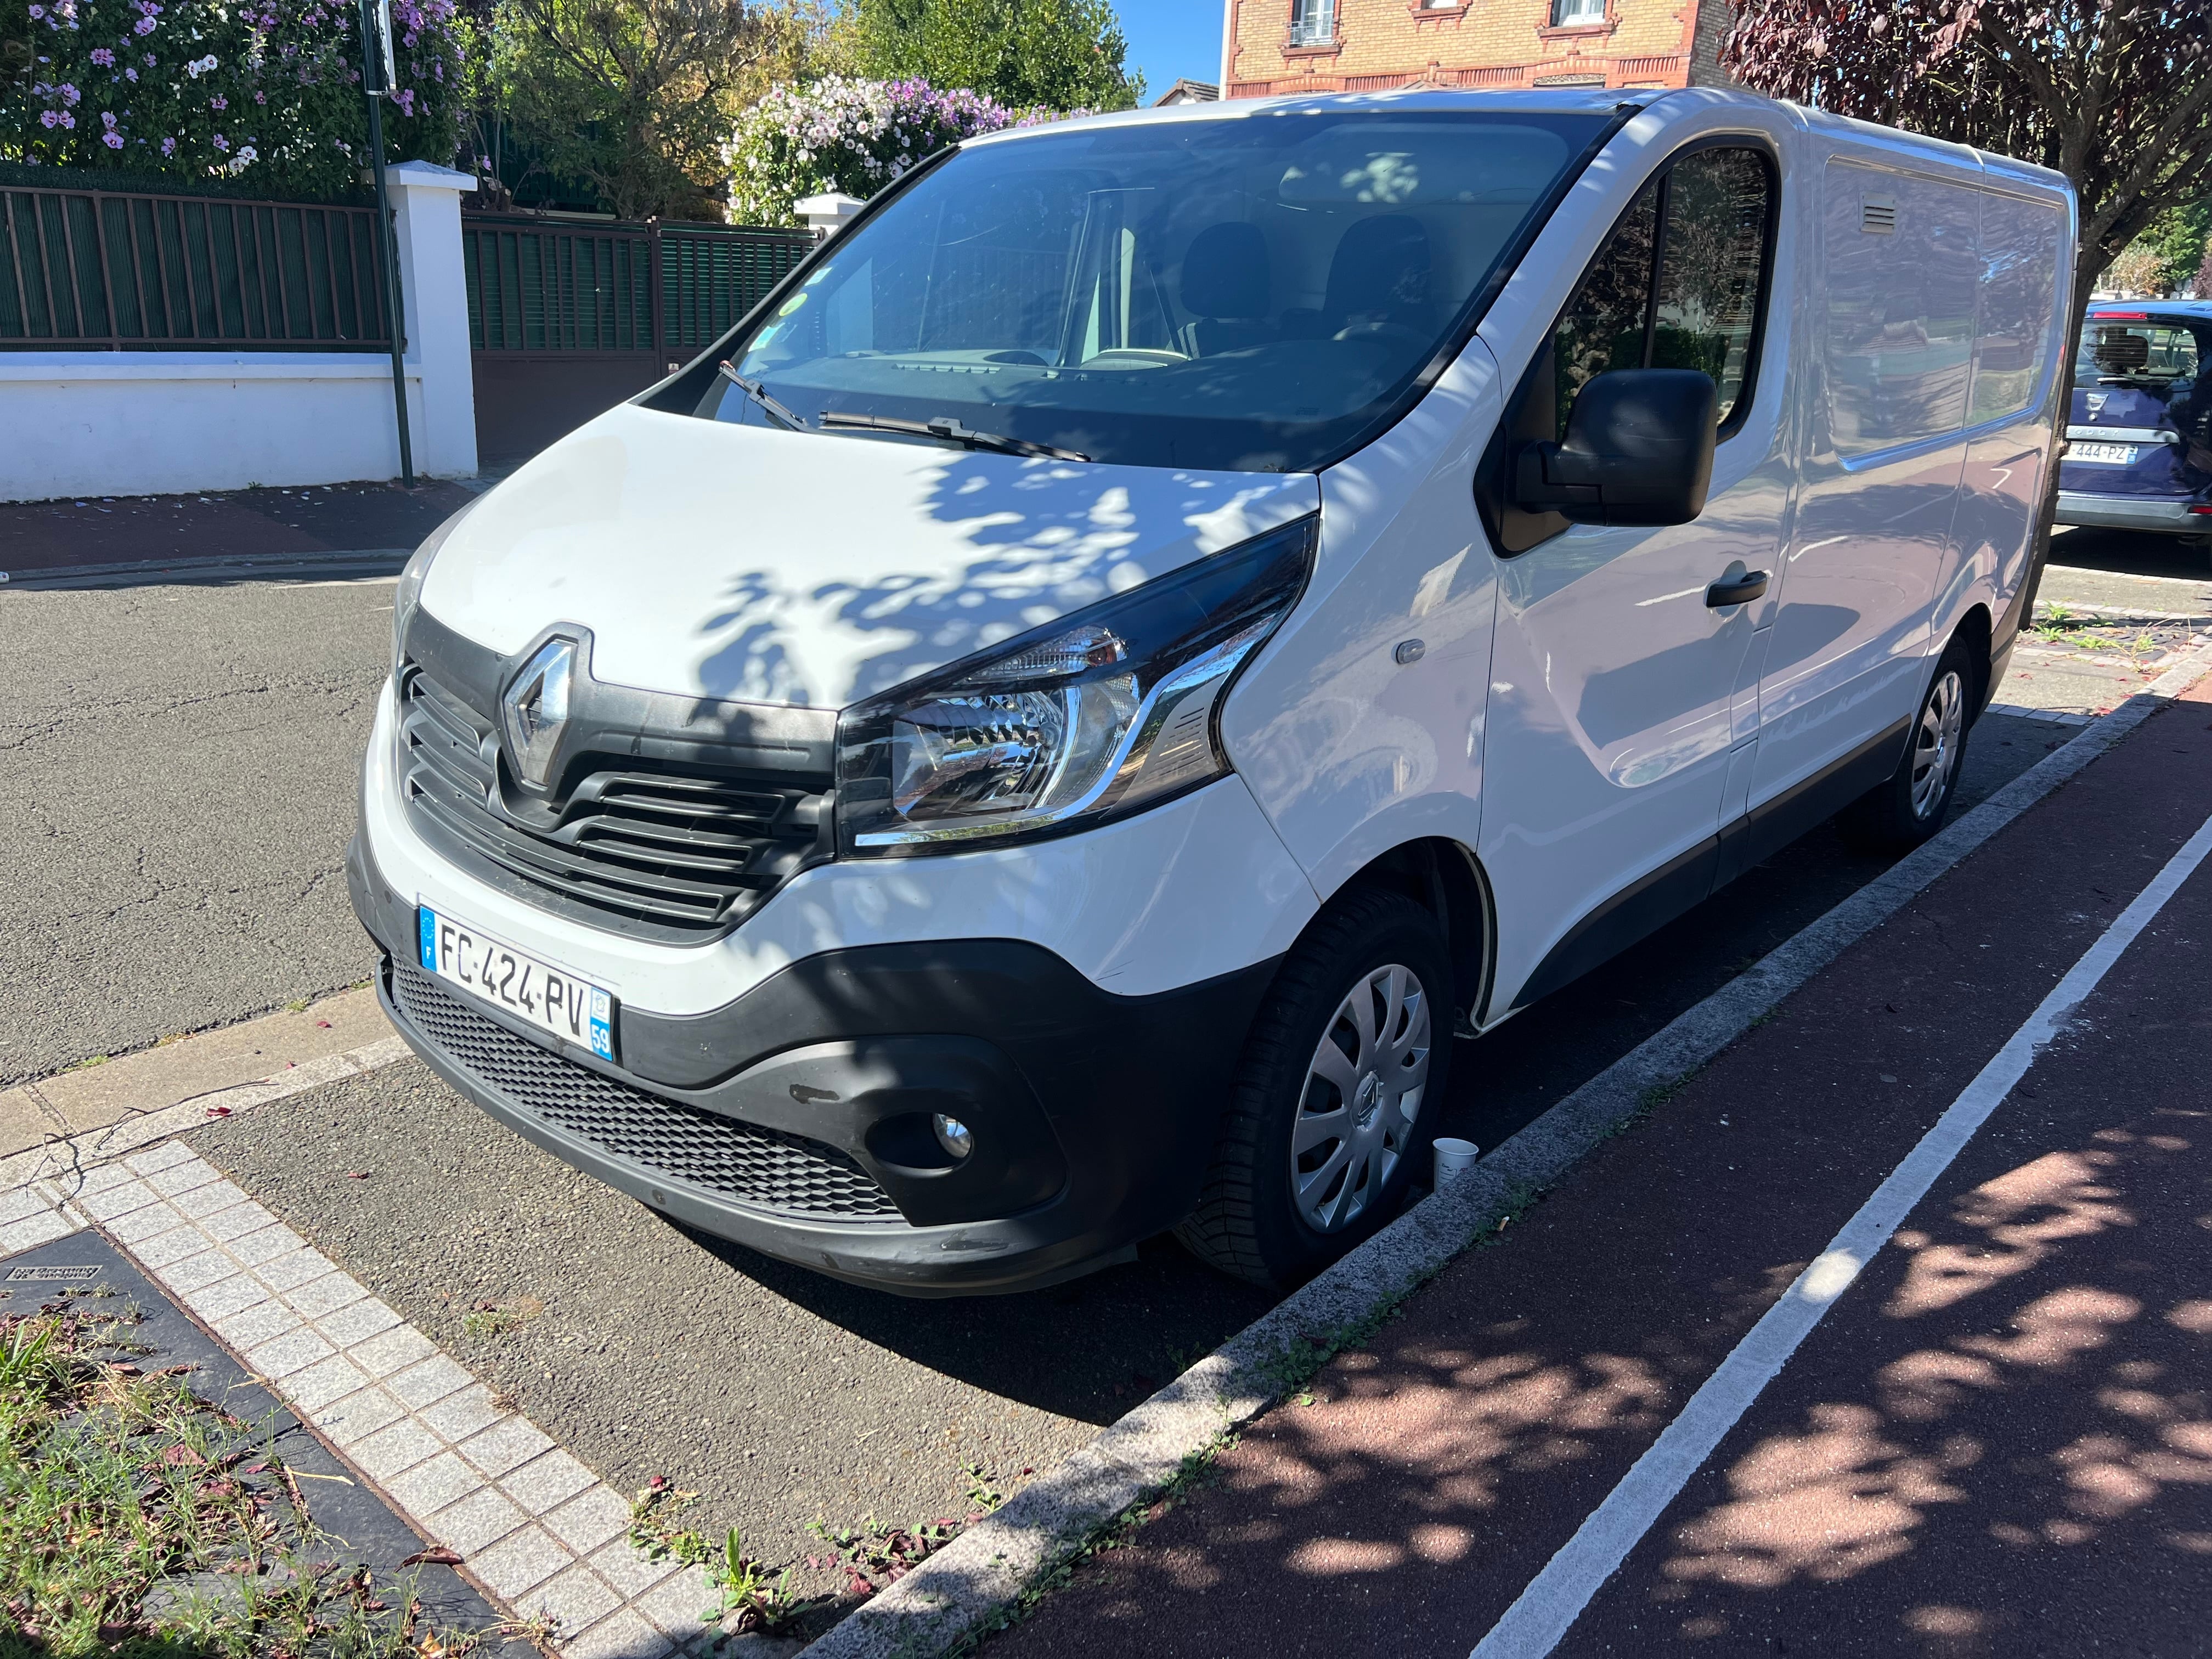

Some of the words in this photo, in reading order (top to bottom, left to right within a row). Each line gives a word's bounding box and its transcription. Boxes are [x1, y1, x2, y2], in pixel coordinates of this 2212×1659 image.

[426, 946, 432, 959] F
[441, 924, 583, 1037] FC-424-PV
[592, 1024, 610, 1053] 59
